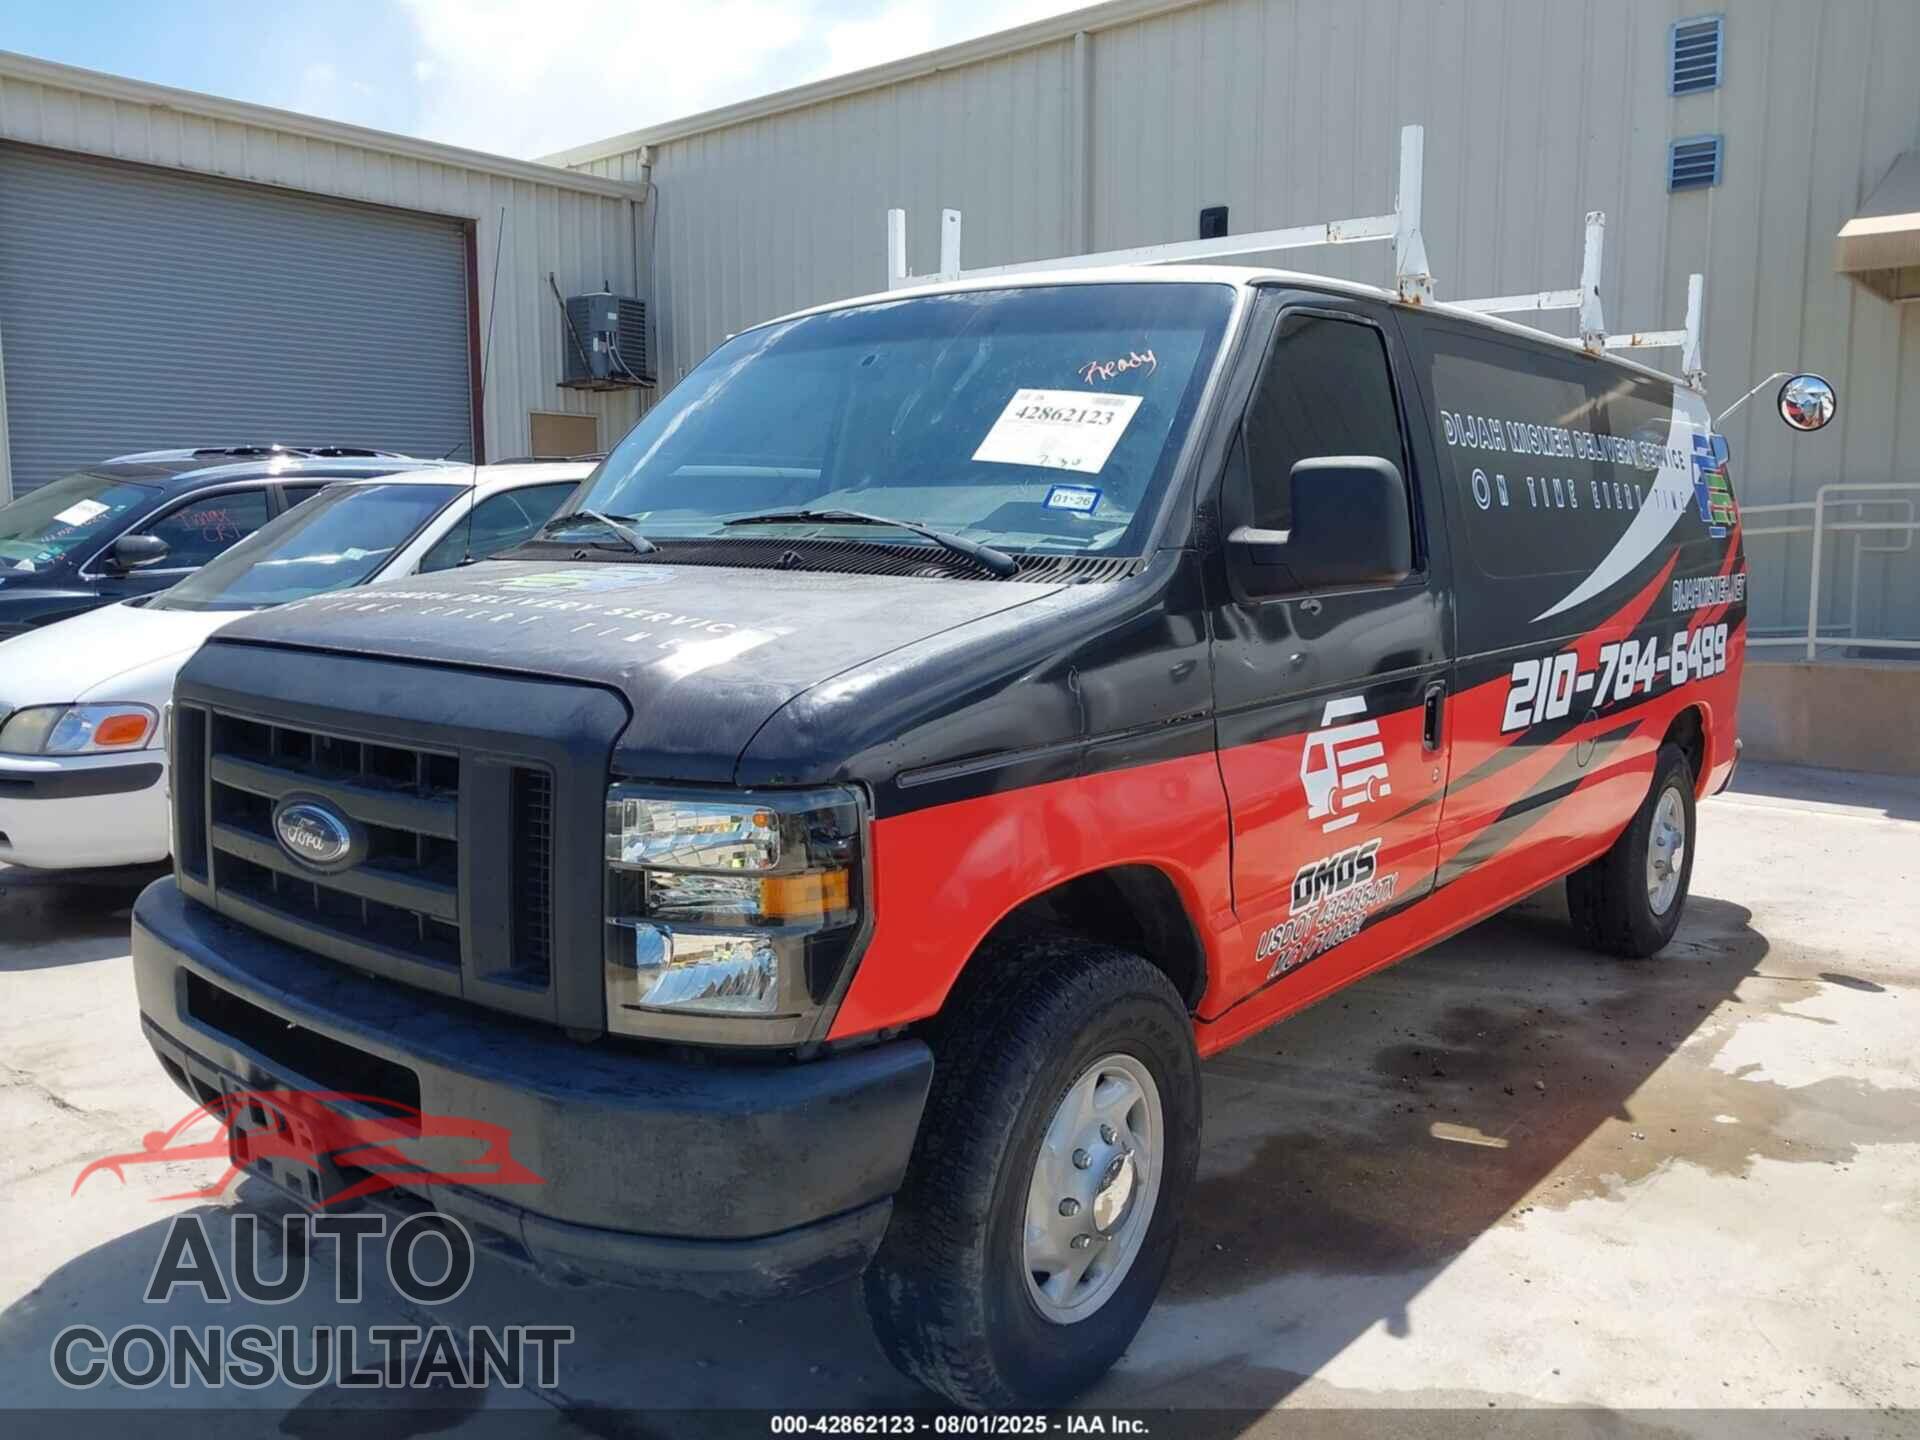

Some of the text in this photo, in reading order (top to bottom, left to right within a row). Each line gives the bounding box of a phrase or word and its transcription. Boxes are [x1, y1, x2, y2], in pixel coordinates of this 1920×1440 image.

[1015, 405, 1115, 425] 42862123
[1440, 410, 1507, 452] DIJAH
[1471, 467, 1510, 511] ON
[604, 607, 738, 634] SERVIC
[1501, 623, 1728, 733] 210-784-6499
[287, 817, 325, 851] Ford
[1255, 904, 1320, 962] USDOT
